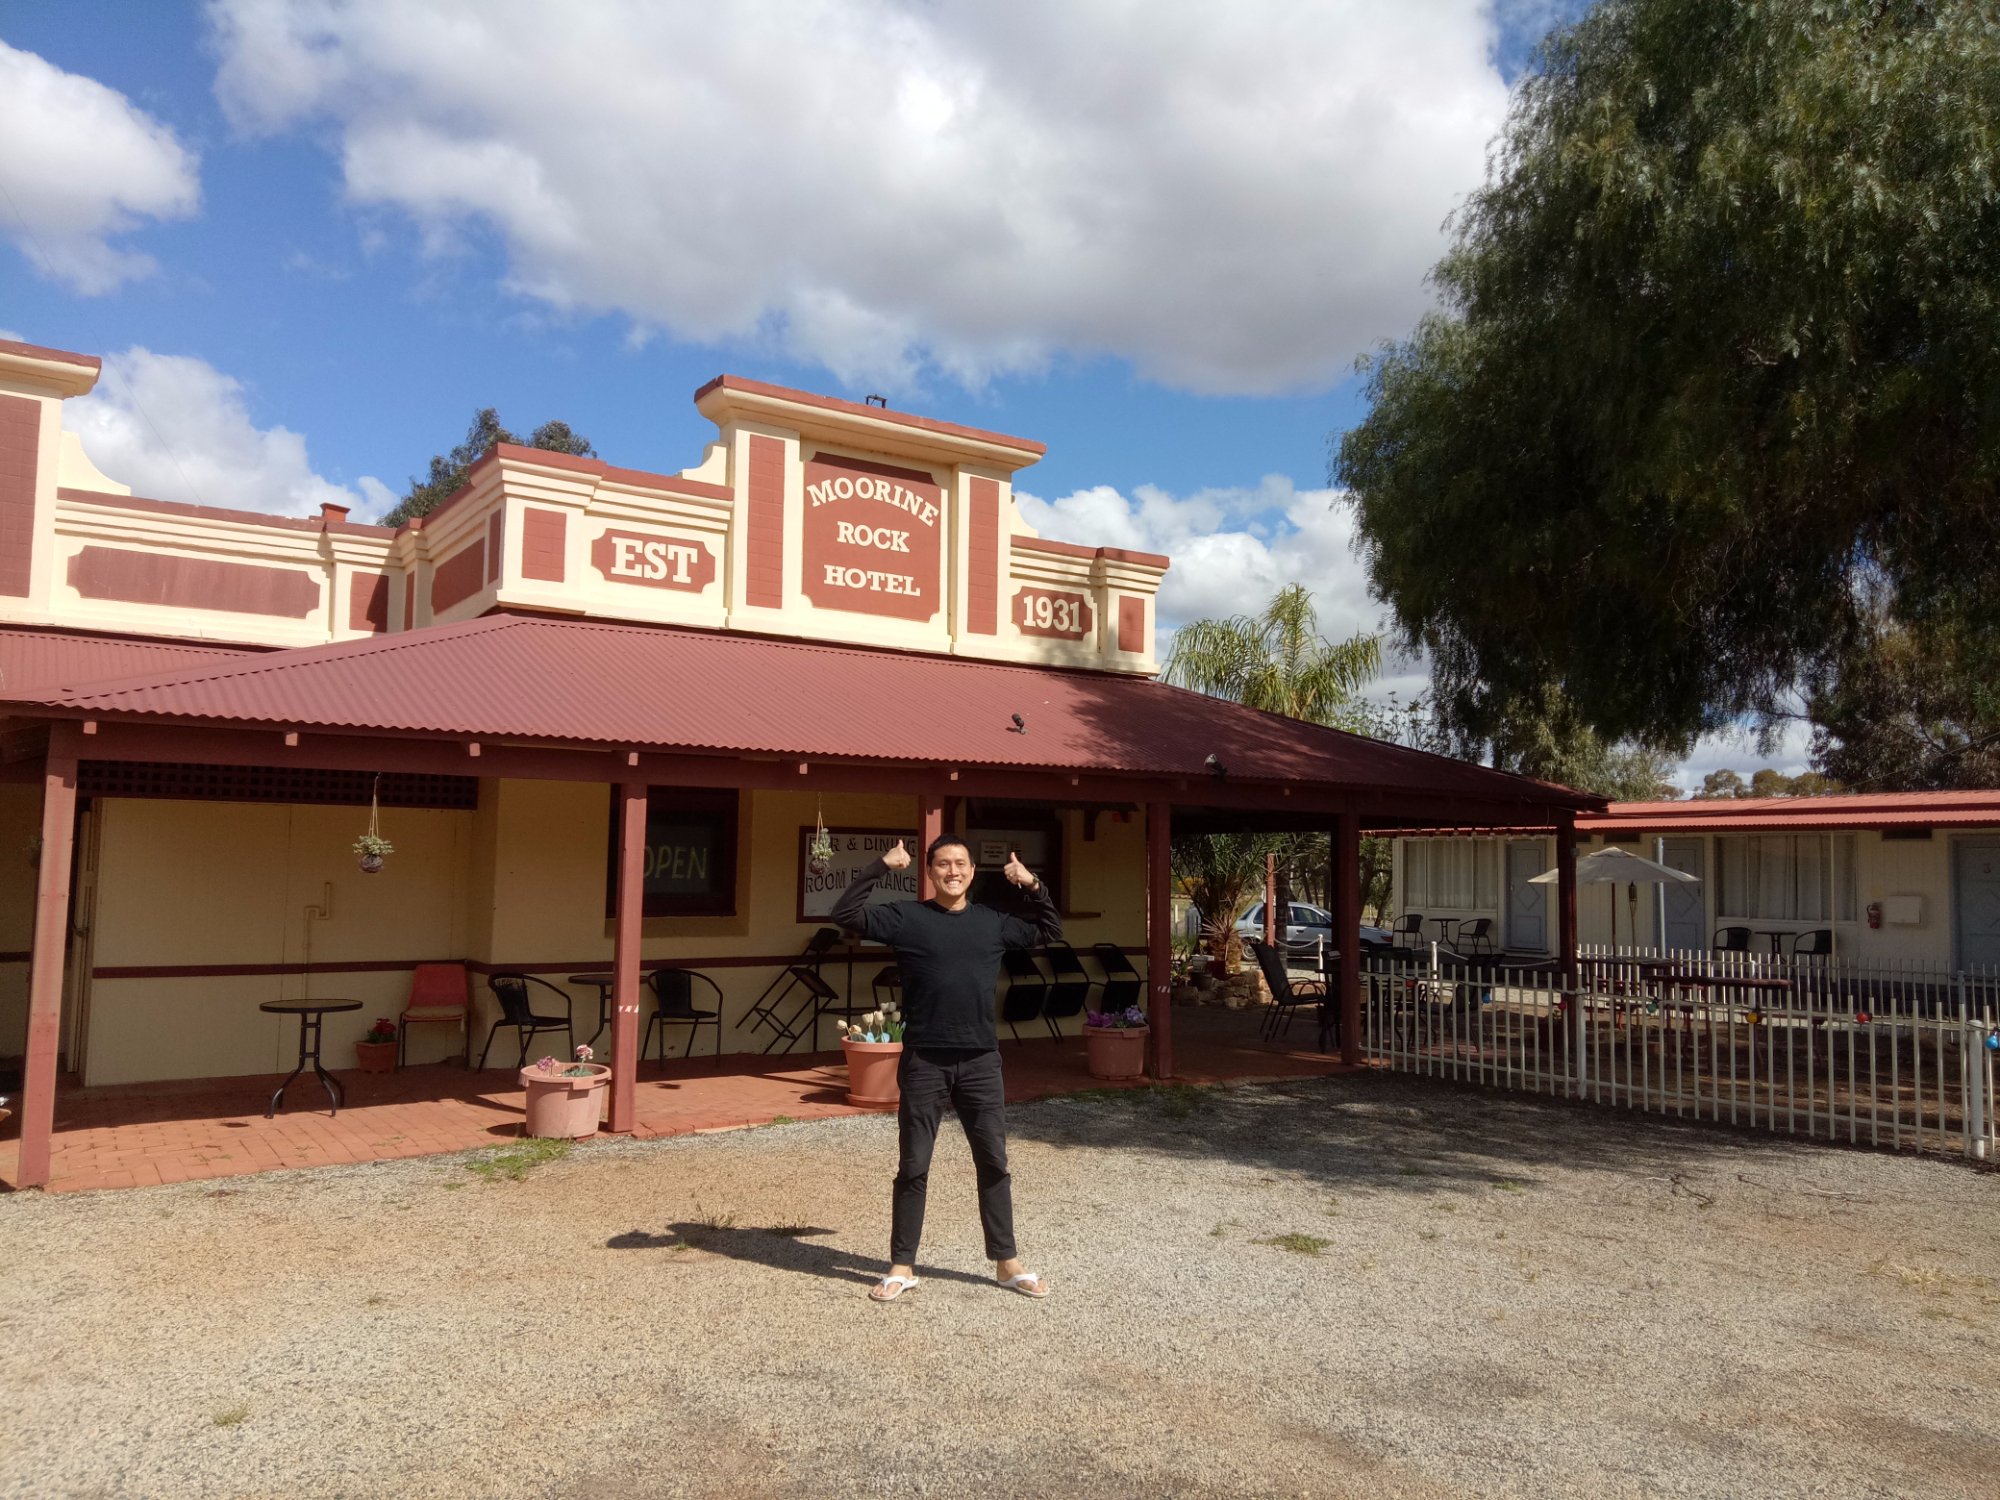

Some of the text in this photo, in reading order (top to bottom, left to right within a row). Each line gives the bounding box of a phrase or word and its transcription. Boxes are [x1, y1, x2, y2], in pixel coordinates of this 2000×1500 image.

[806, 477, 939, 527] MOORINE
[837, 520, 910, 553] ROCK
[610, 536, 698, 584] EST
[823, 564, 921, 597] HOTEL
[1023, 594, 1083, 633] 1931
[846, 835, 859, 851] &
[805, 869, 846, 894] ROOM
